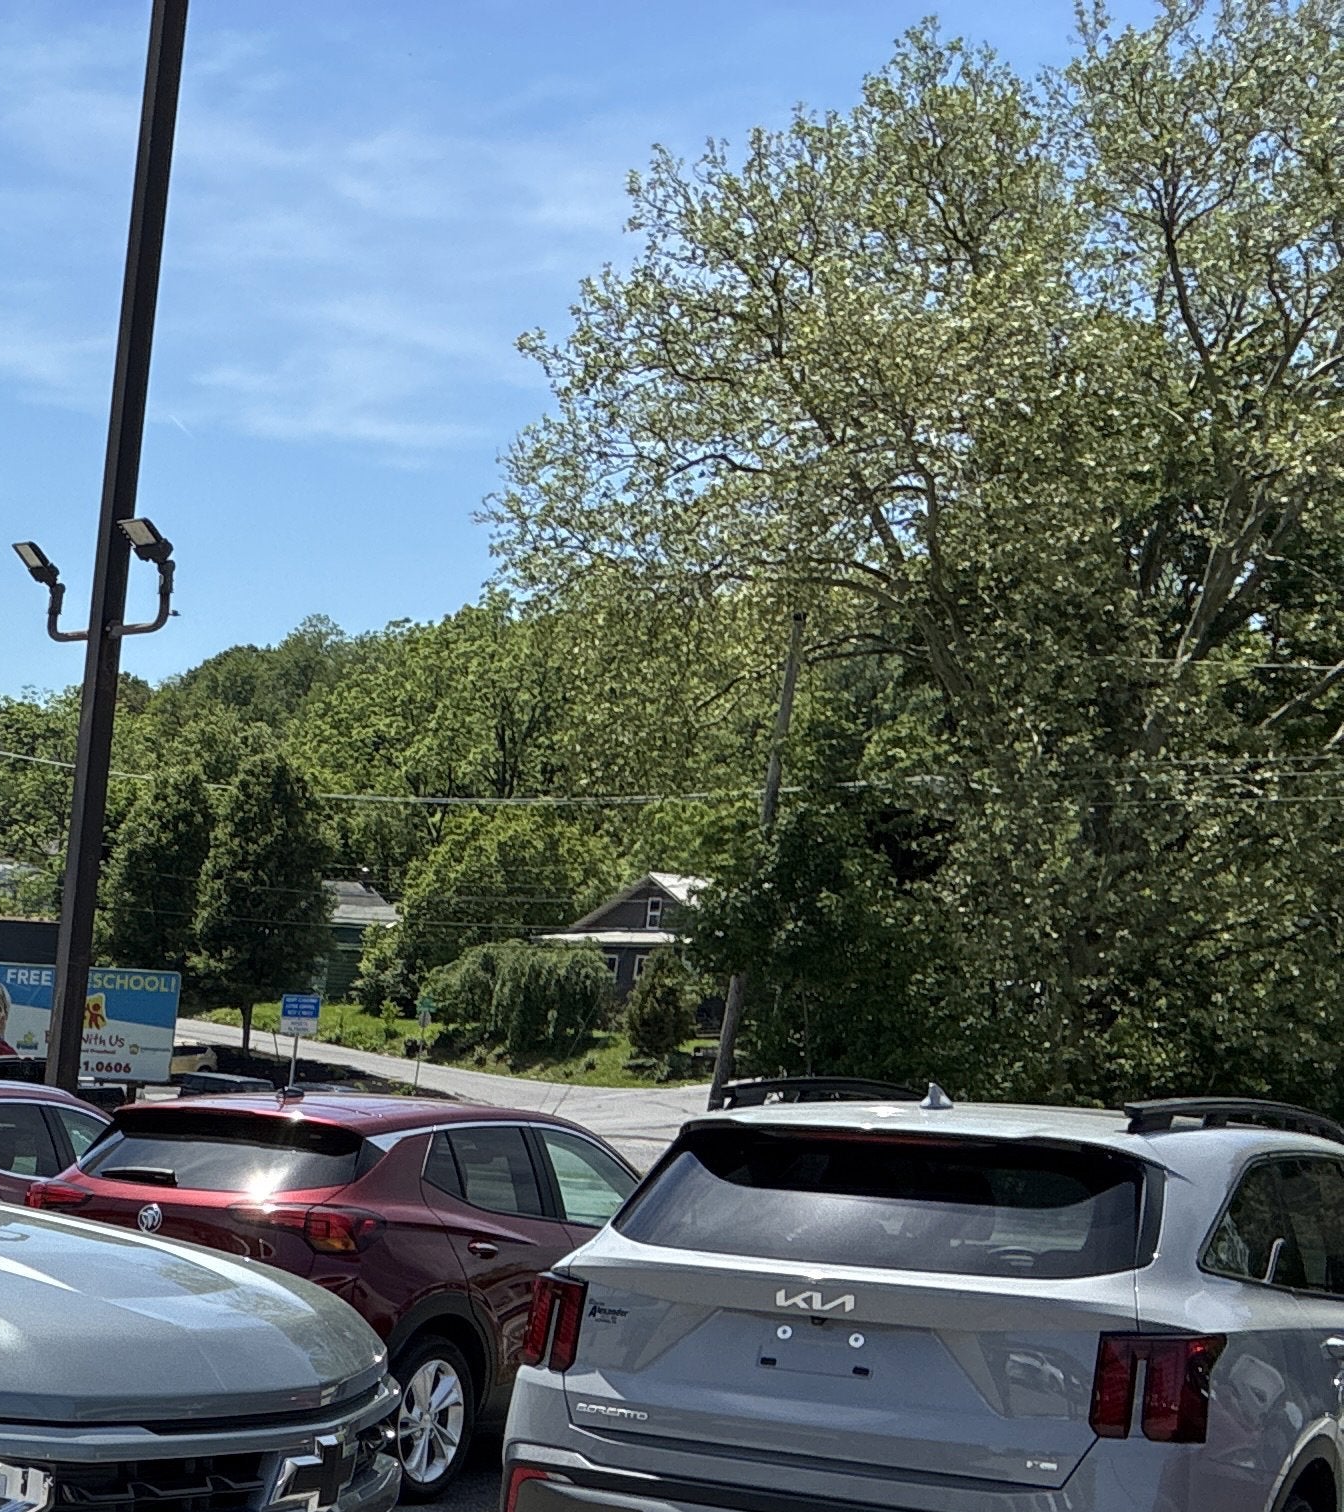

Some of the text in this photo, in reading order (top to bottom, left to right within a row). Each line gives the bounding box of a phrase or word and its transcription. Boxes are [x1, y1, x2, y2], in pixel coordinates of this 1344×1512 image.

[5, 968, 177, 993] FREE SCHOOL!
[108, 1034, 126, 1048] Us
[79, 1060, 132, 1074] 1.0606
[775, 1288, 855, 1313] KIA
[575, 1402, 649, 1421] SORENTO
